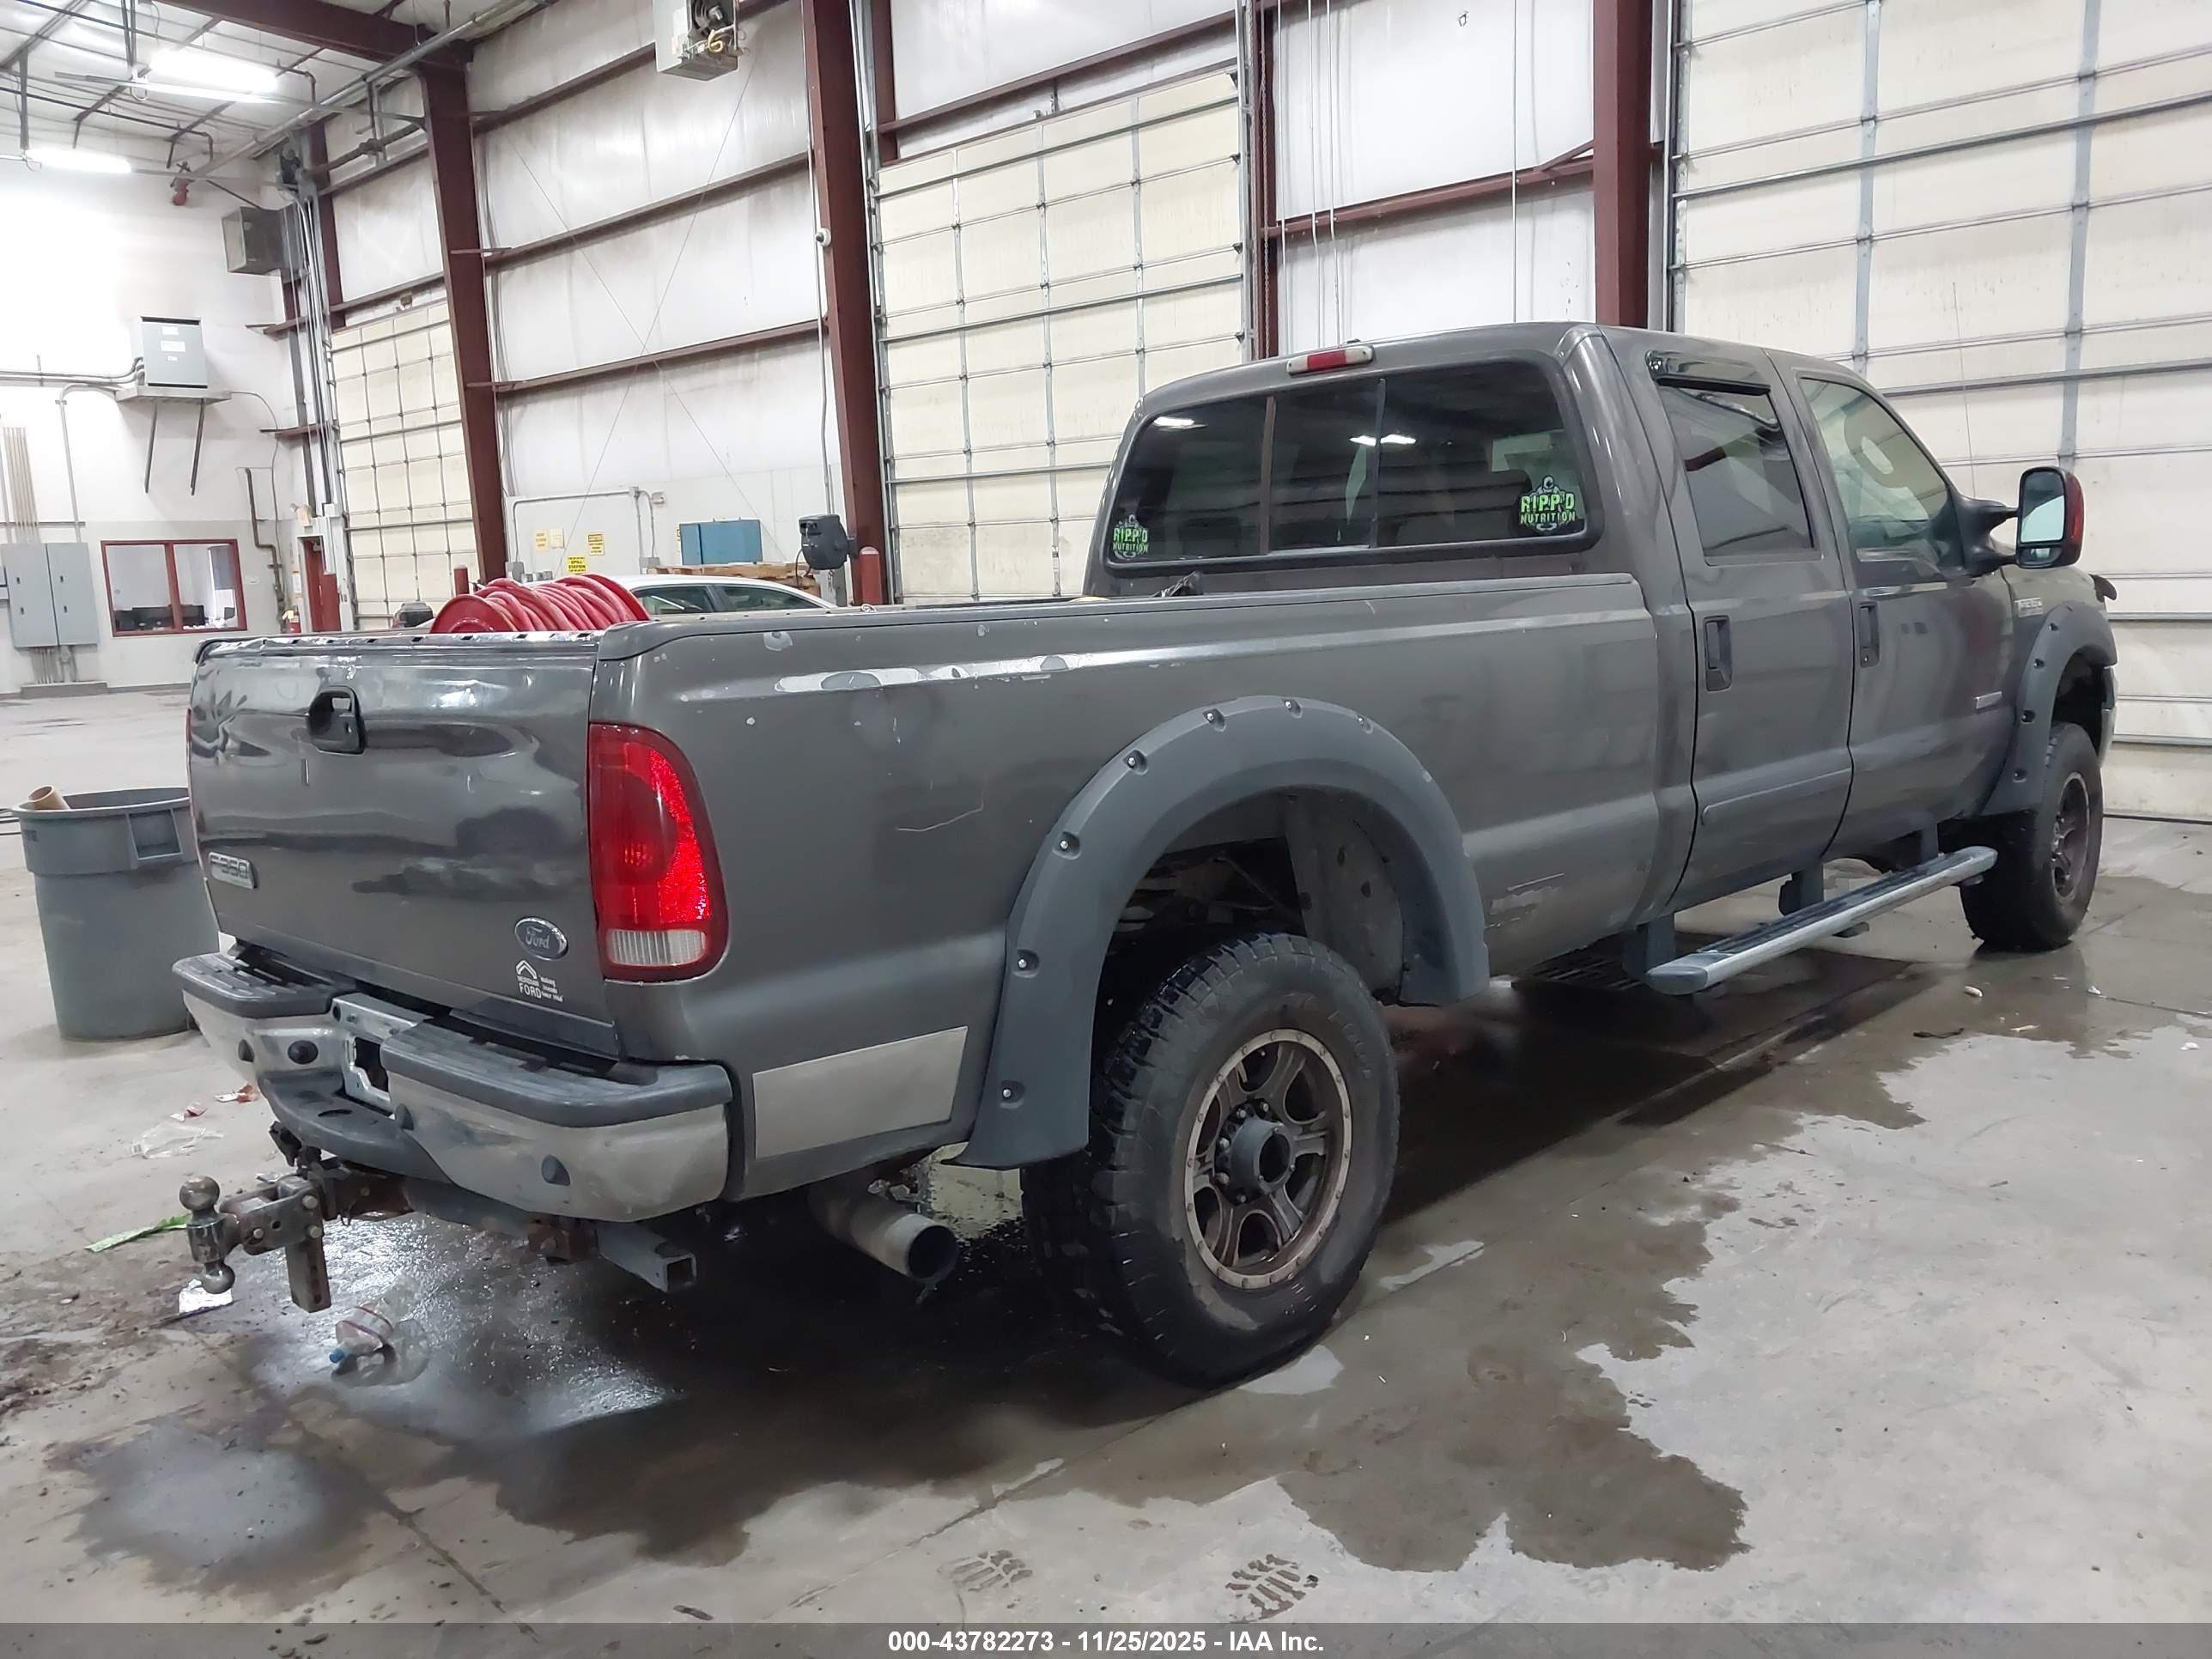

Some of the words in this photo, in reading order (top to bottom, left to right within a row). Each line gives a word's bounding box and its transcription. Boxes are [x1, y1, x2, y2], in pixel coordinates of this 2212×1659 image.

[1521, 493, 1575, 513] RIPP'D
[1520, 511, 1576, 525] NUTRITION
[1113, 542, 1149, 554] NUTRITION
[526, 927, 550, 948] Ford
[520, 982, 542, 999] FORD
